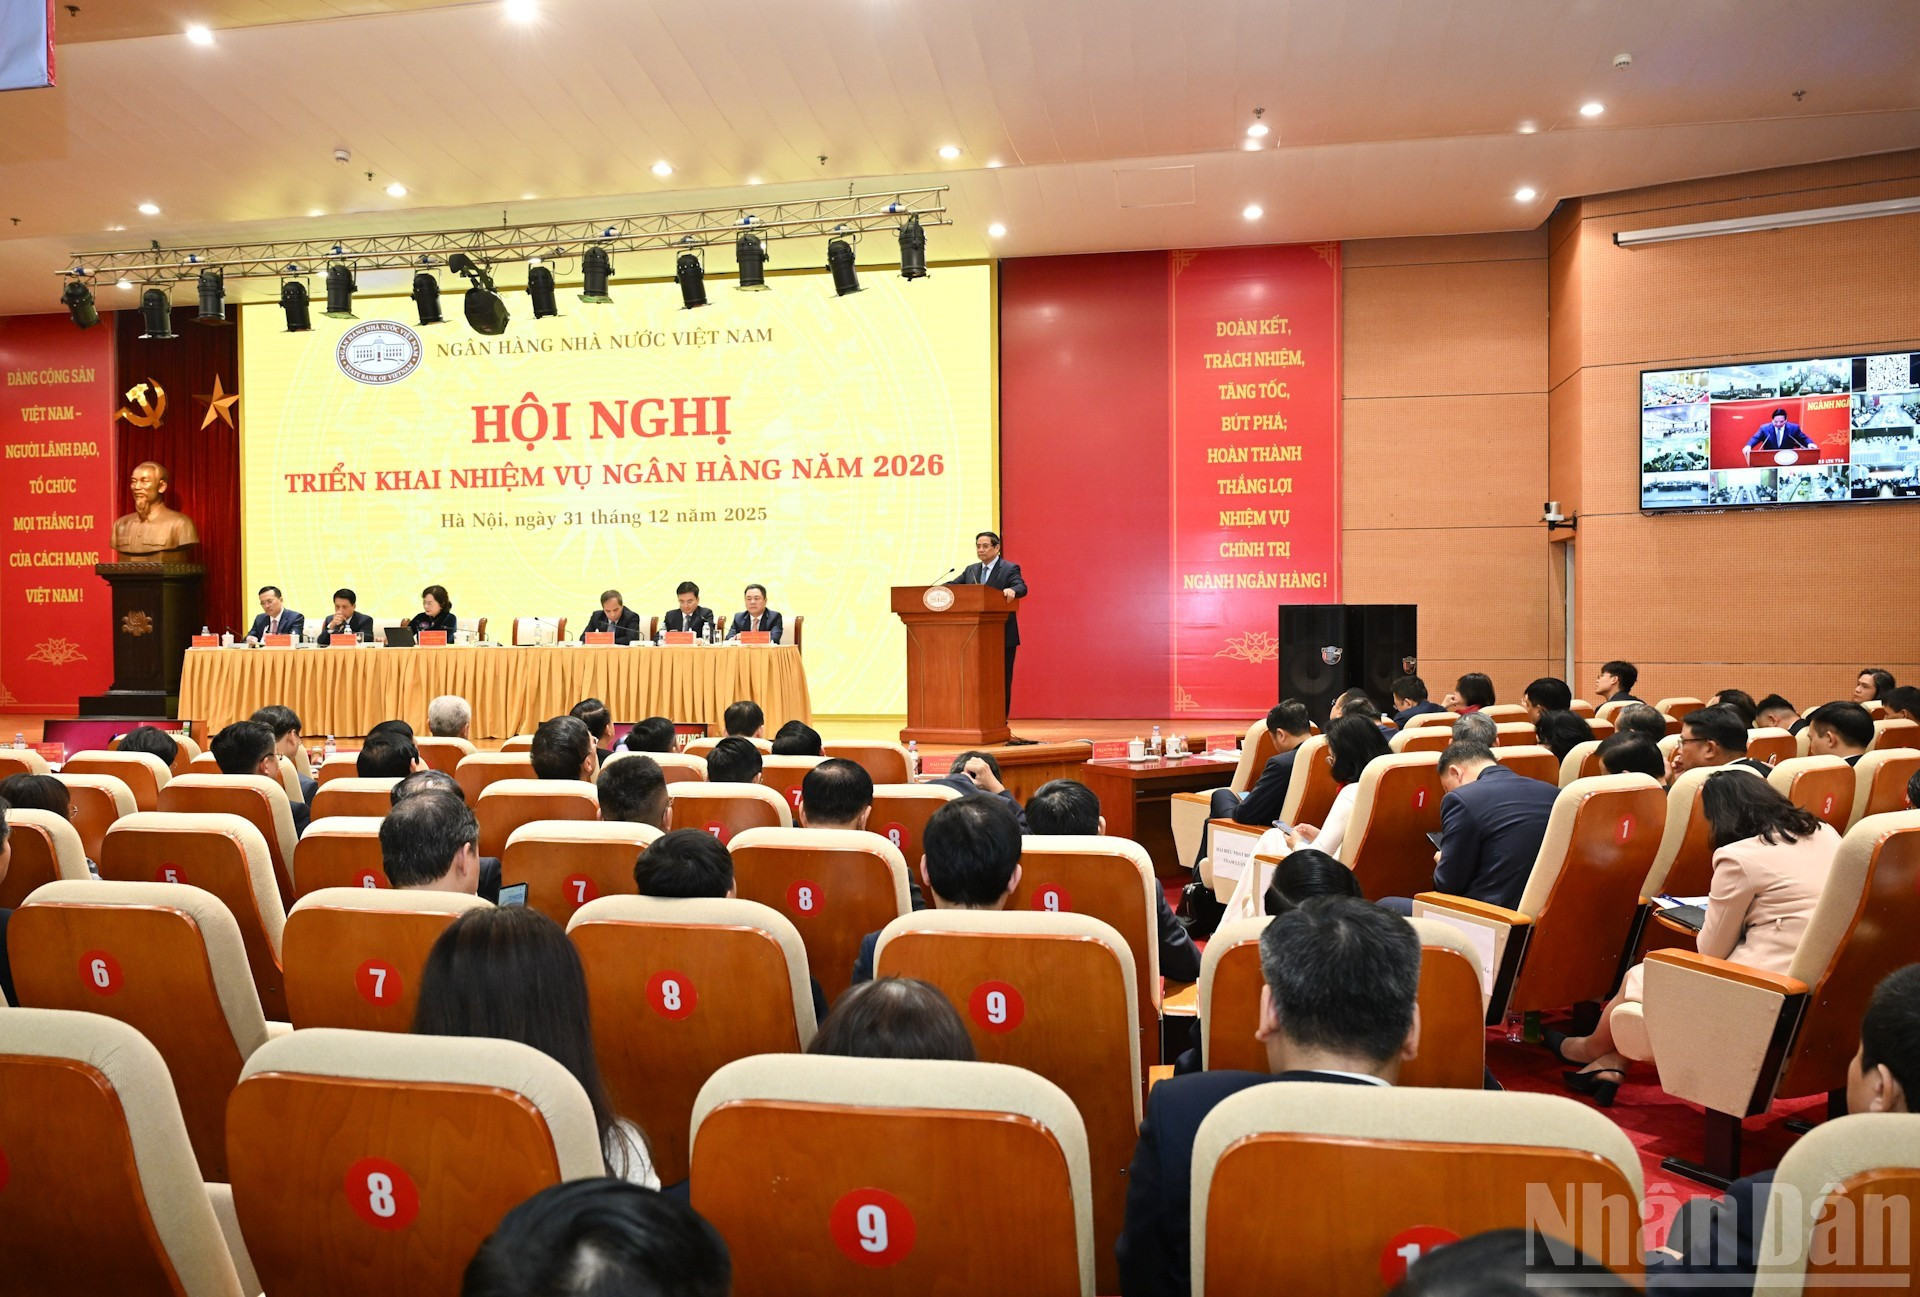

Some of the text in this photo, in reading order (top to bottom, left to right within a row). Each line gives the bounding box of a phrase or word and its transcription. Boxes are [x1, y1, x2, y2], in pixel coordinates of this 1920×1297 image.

[365, 323, 381, 331] NHÀ
[1216, 315, 1291, 337] ĐOÀN KẾT,
[437, 327, 774, 357] NGÂN HÀNG NHÀ NƯỚC VIỆT NAM
[1204, 347, 1305, 369] TRÁCH NHIỆM,
[7, 365, 95, 387] ĐẢNG CỘNG SẢN
[344, 362, 415, 382] STATE BANK OF VIETNAM
[1218, 378, 1290, 400] TĂNG TỐC,
[21, 404, 46, 424] VIỆT
[48, 406, 74, 421] NAM
[1807, 400, 1835, 411] NGÀNH
[472, 391, 732, 452] HỘI NGHỊ
[1221, 411, 1288, 432] BÚT PHÁ;
[5, 440, 100, 459] NGƯỜI LÃNH ĐẠO,
[1207, 443, 1302, 464] HOÀN THÀNH
[285, 452, 944, 493] TRIỂN KHAI NHIỆM VỤ NGÂN HÀNG NĂM 2026
[29, 474, 77, 494] TỔ CHỨC
[1217, 473, 1293, 496] THẮNG LỢI
[13, 510, 95, 534] MỌI THẮNG LỢI
[441, 506, 768, 531] Hà Nội, ngày 31 tháng 12 năm 2025
[1219, 507, 1290, 528] NHIỆM VỤ
[9, 549, 99, 568] CỦA CÁCH MẠNG
[1219, 539, 1290, 559] CHÍNH TRỊ
[1183, 571, 1235, 590] NGÀNH
[1236, 570, 1278, 589] NGÂN
[26, 586, 51, 606] VIỆT
[792, 790, 802, 806] 7
[1417, 791, 1425, 807] 1
[1824, 797, 1832, 814] 3
[888, 828, 900, 848] 8
[1621, 820, 1630, 838] 1
[165, 869, 177, 883] 5
[573, 880, 586, 902] 7
[799, 888, 812, 910] 8
[1043, 891, 1059, 912] 9
[92, 960, 109, 987] 6
[370, 969, 386, 997] 7
[662, 980, 680, 1010] 8
[987, 992, 1006, 1023] 9
[368, 1173, 395, 1216] 8
[858, 1205, 887, 1251] 9
